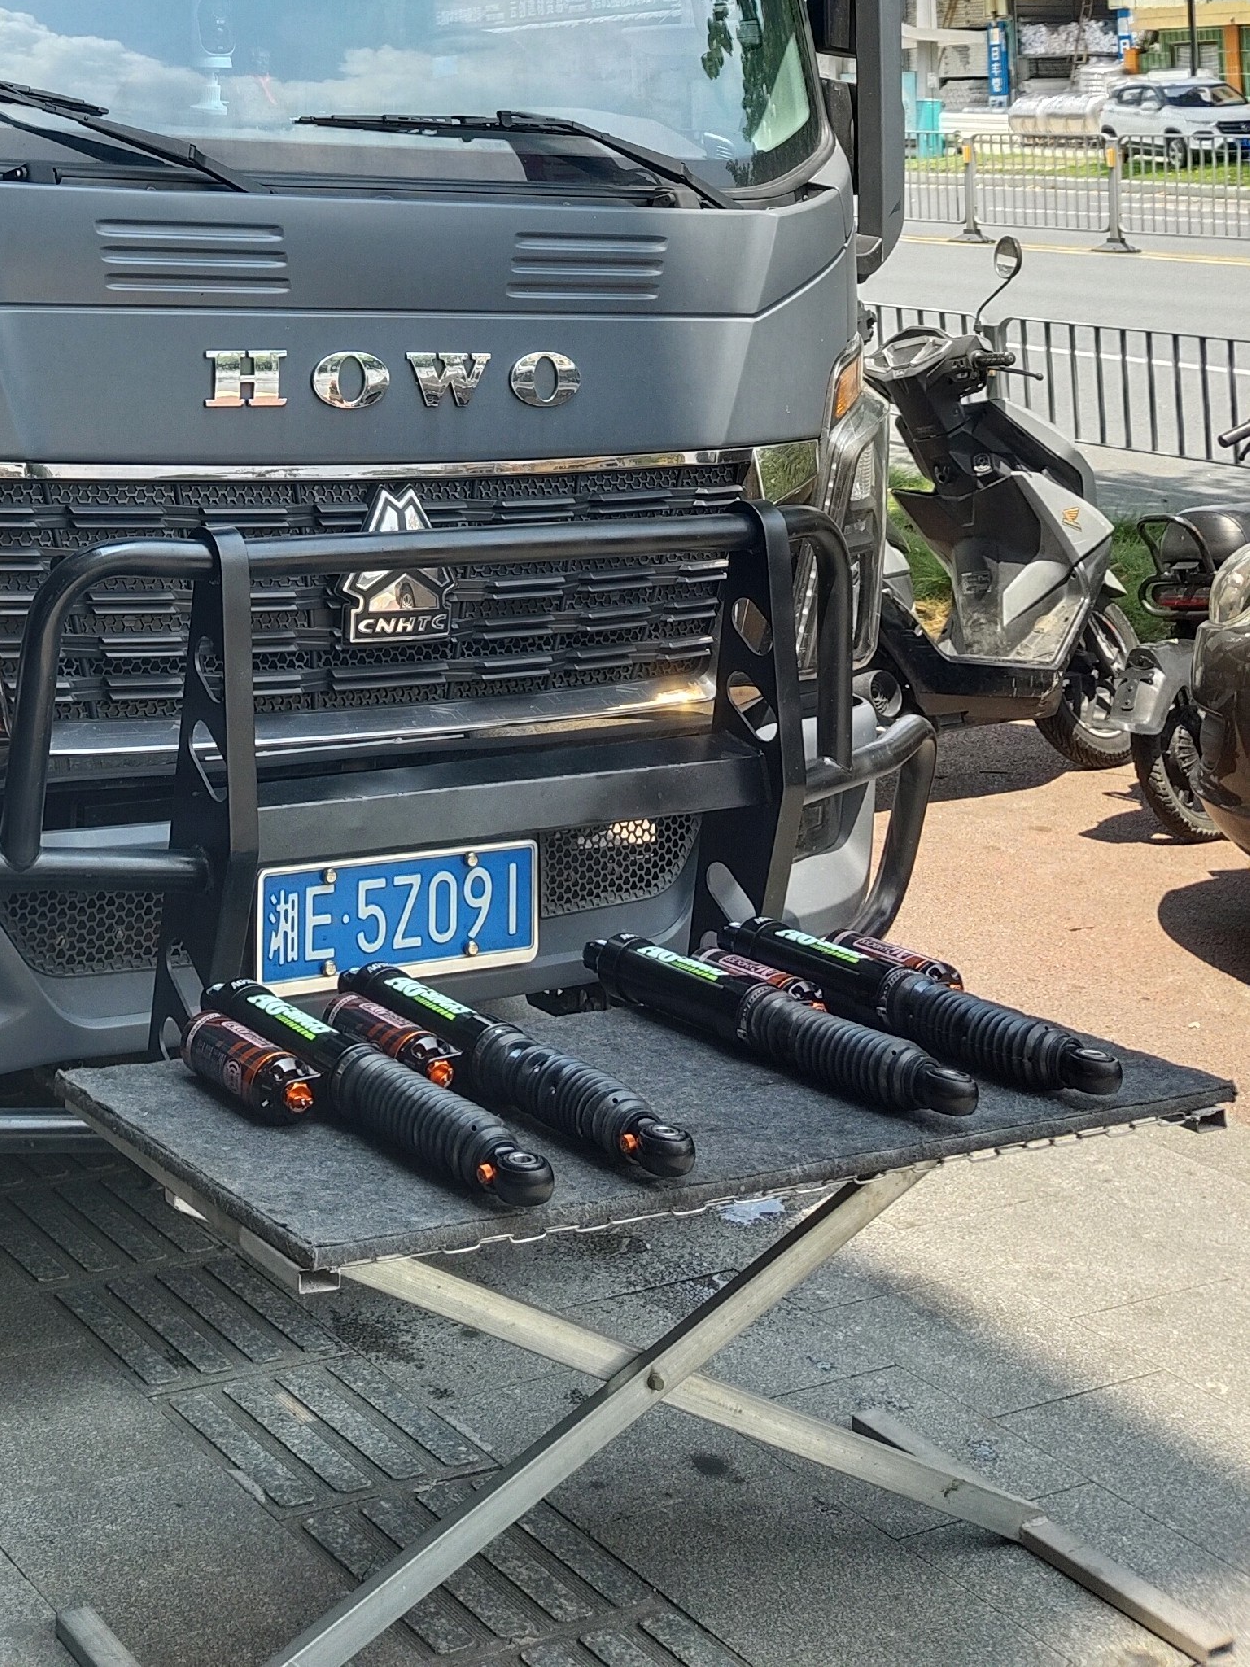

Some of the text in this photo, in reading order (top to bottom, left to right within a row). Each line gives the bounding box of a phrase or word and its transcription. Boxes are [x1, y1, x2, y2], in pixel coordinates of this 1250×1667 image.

[205, 349, 581, 408] HOWO
[357, 614, 447, 633] CNHTC
[269, 862, 518, 965] 湘E·5Z091
